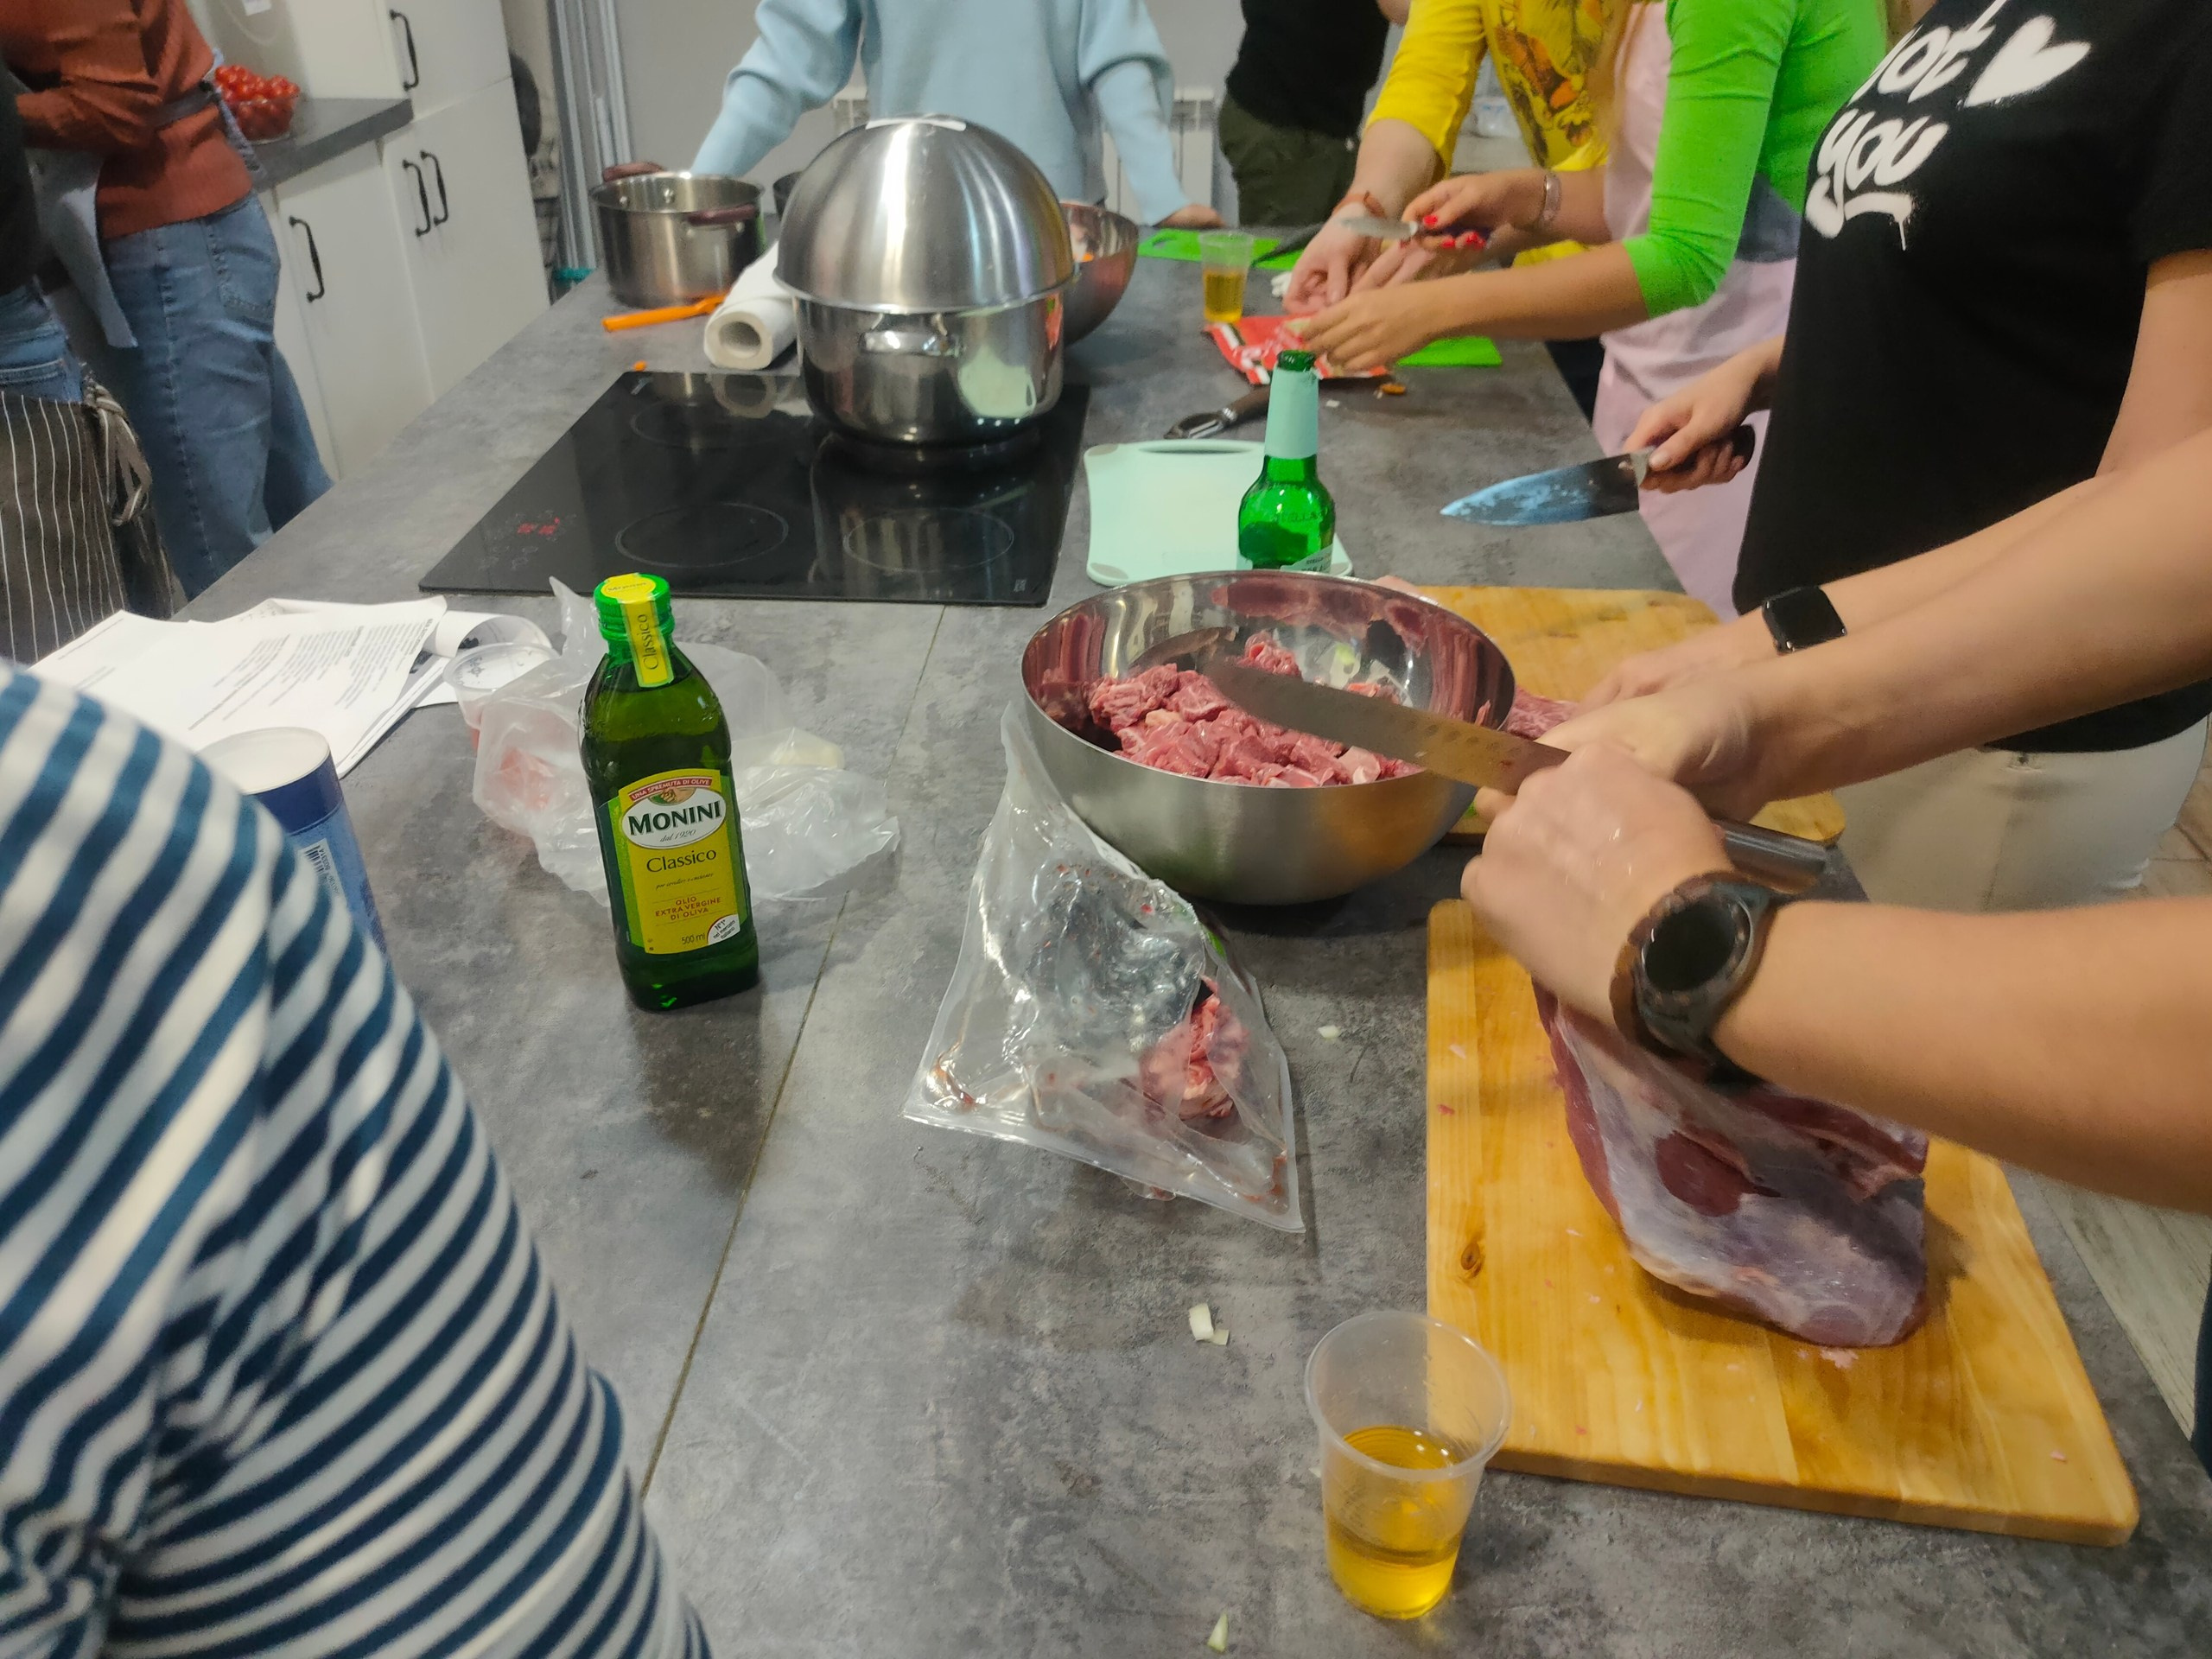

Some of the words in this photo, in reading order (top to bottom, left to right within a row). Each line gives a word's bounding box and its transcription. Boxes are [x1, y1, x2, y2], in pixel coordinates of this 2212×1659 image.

[637, 613, 659, 671] Classico
[631, 790, 647, 800] UNA
[647, 780, 681, 793] SPREMUTA
[627, 800, 722, 836] MONINI
[659, 834, 674, 843] dal
[674, 829, 697, 842] 1920
[645, 849, 717, 874] Classico
[654, 905, 683, 917] EXTRA
[684, 896, 722, 910] VERGINE
[675, 895, 697, 906] OLIO
[683, 907, 709, 918] OLIVA
[681, 934, 696, 945] 500
[696, 932, 707, 942] ml
